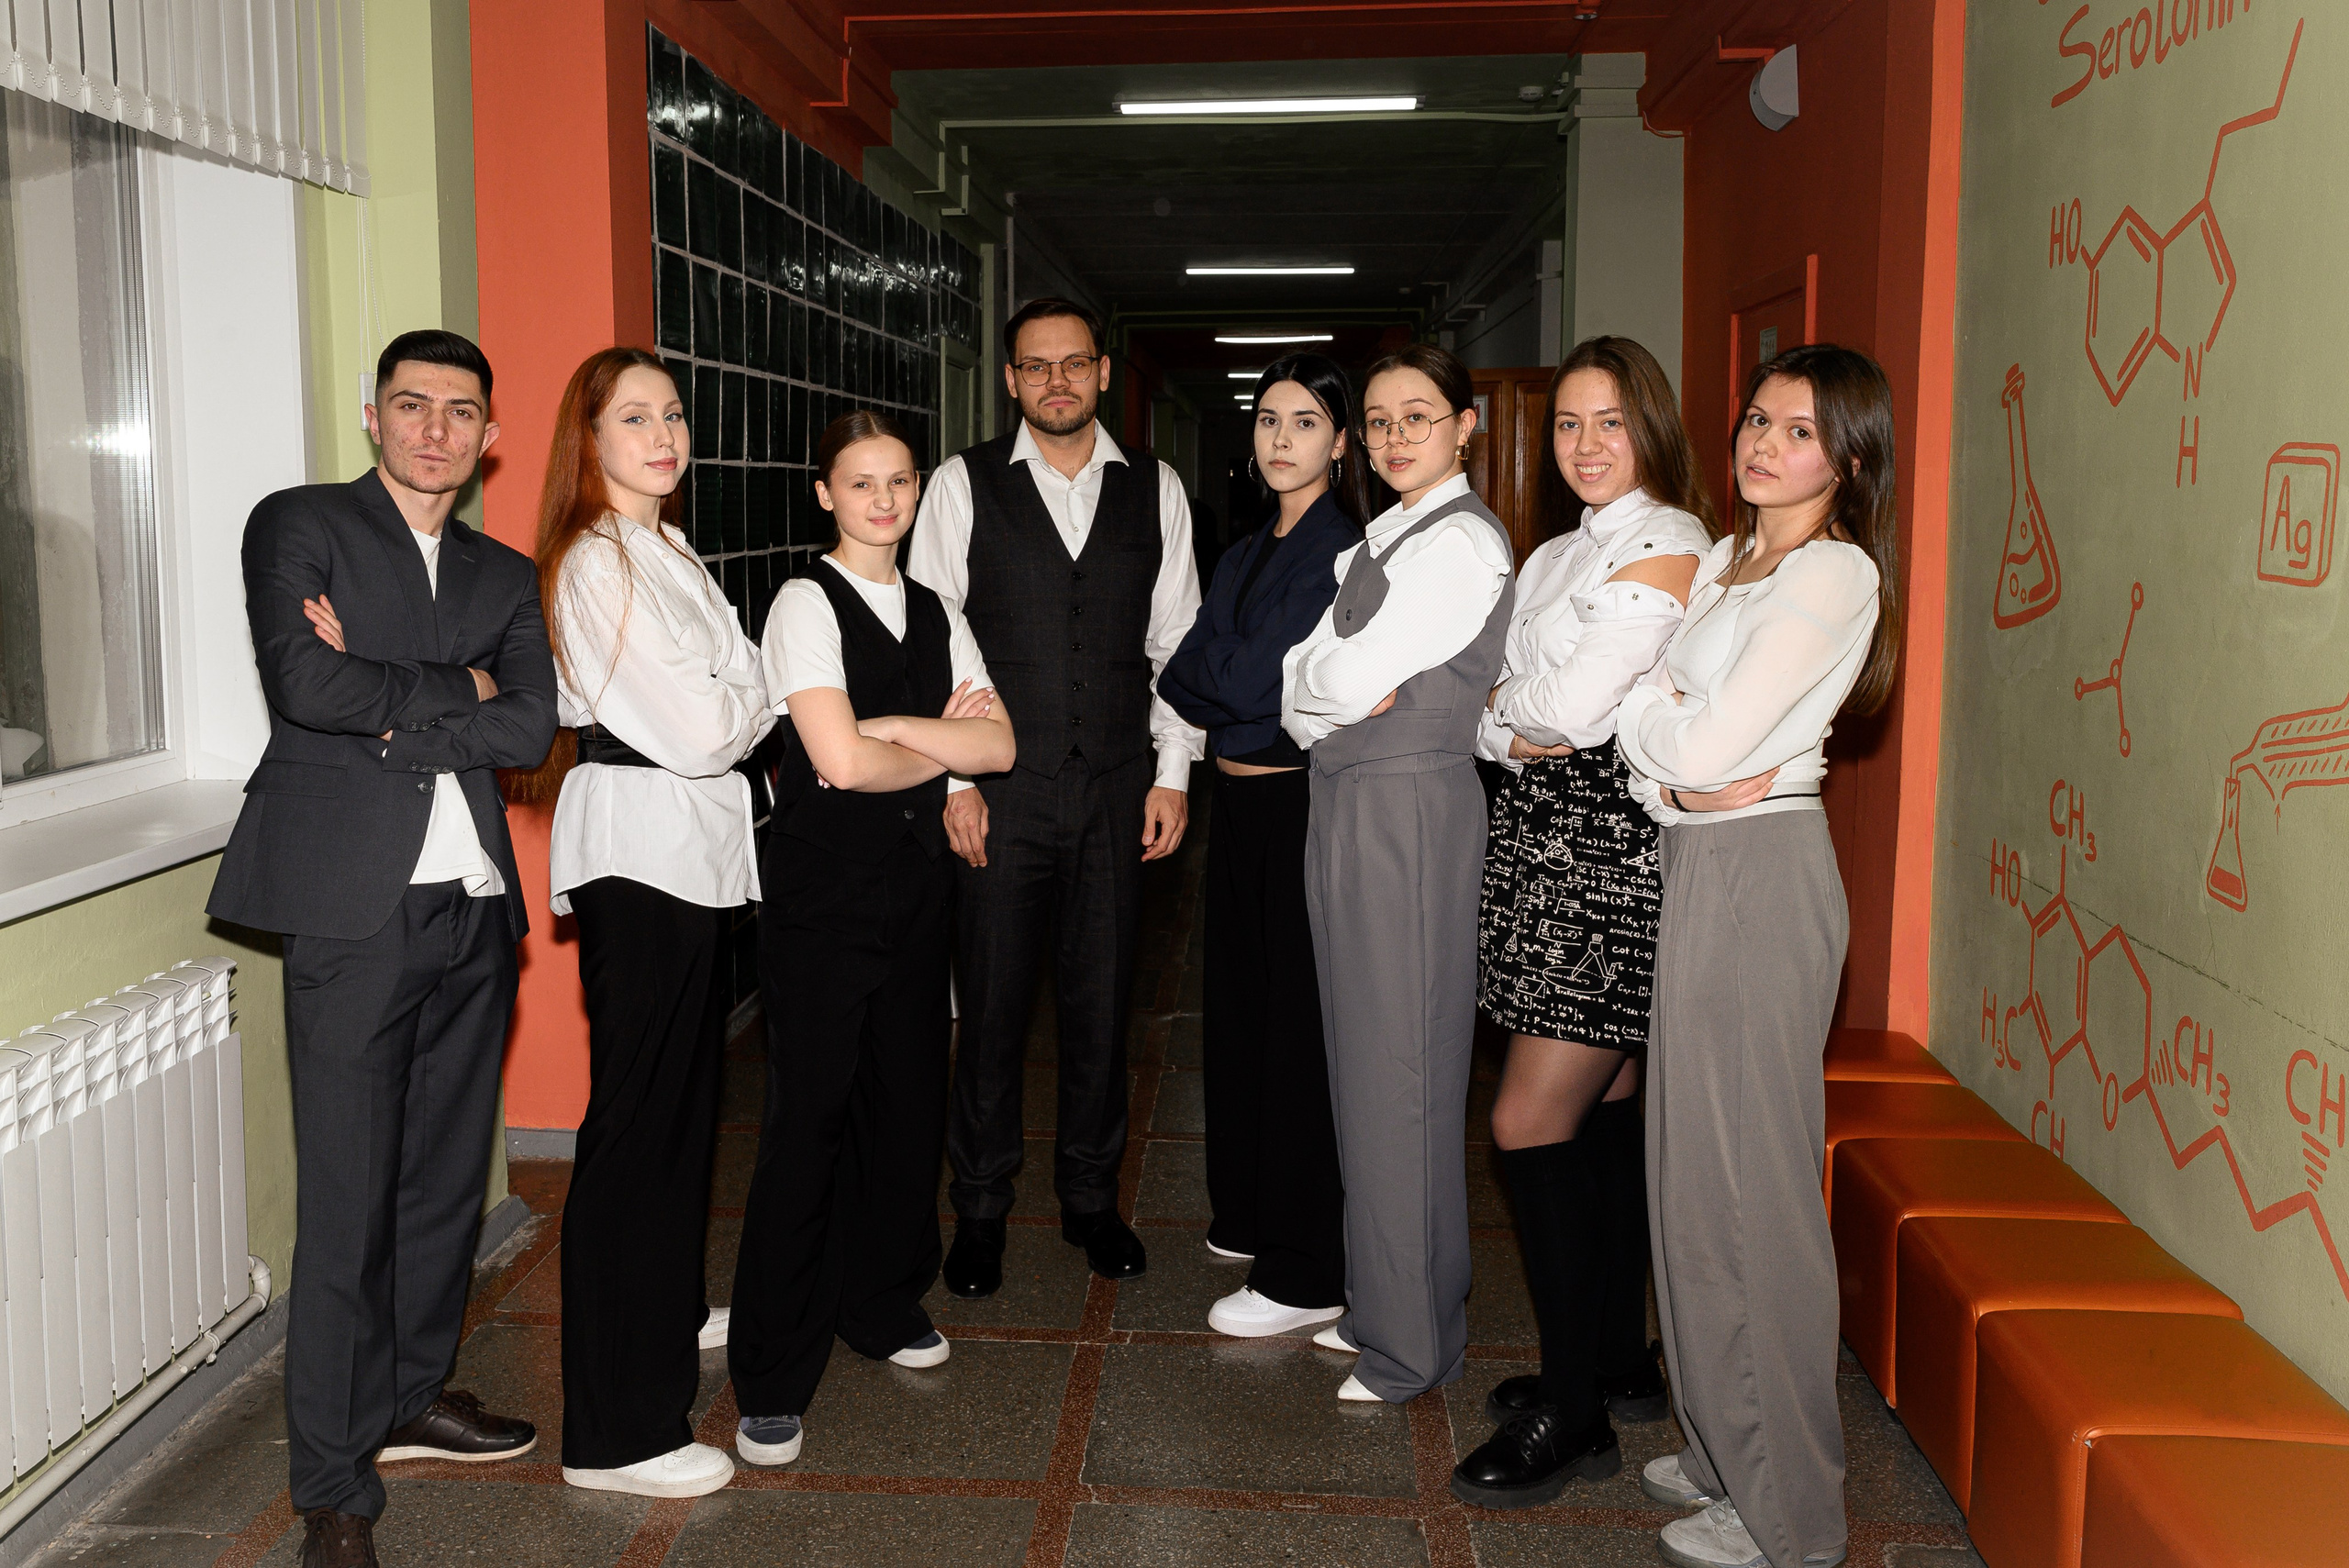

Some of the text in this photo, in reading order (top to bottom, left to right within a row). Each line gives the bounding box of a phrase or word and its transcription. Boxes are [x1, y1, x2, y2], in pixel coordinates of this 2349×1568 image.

[2049, 197, 2081, 269] HO
[2184, 342, 2203, 401] N
[2176, 416, 2199, 487] H
[2270, 475, 2311, 570] Ag
[1990, 838, 2021, 906] HO
